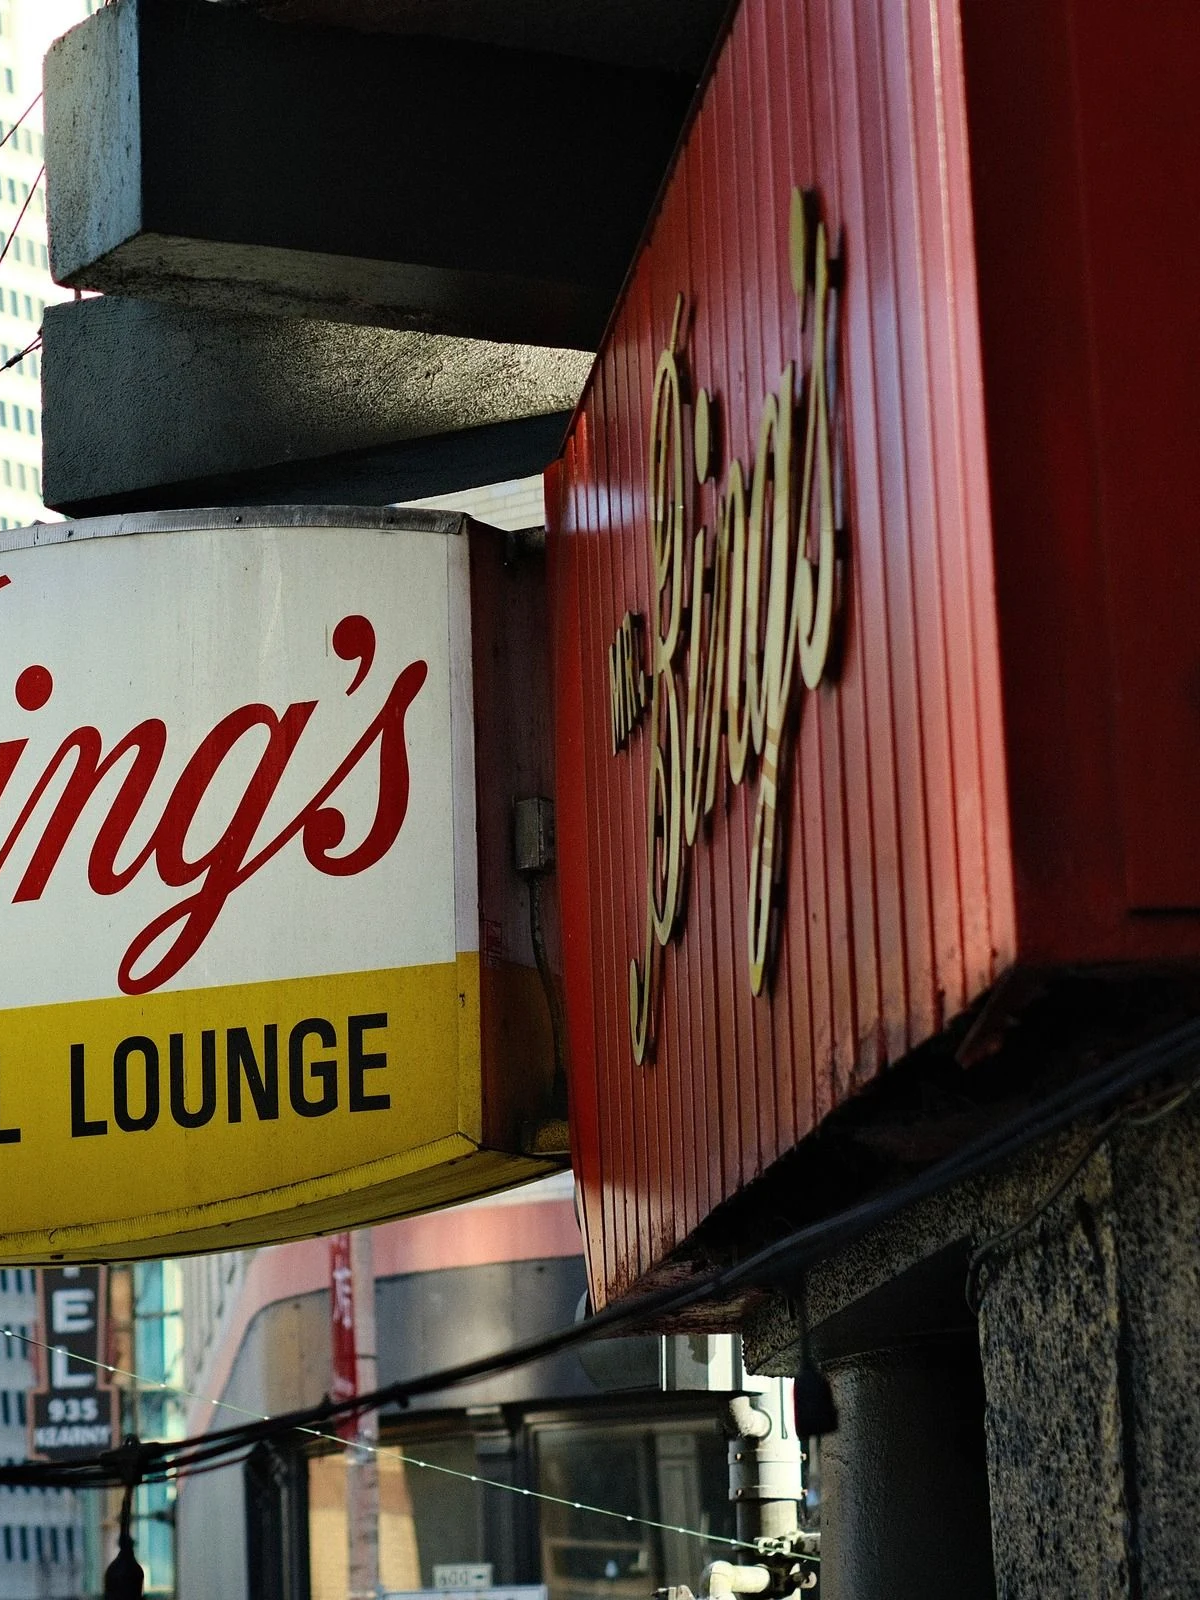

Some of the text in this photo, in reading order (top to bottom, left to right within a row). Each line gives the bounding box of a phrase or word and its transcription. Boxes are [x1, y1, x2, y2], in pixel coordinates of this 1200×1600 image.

[608, 609, 646, 758] MR.
[70, 1012, 392, 1138] LOUNGE
[51, 1265, 96, 1389] EL
[47, 1397, 99, 1422] 935
